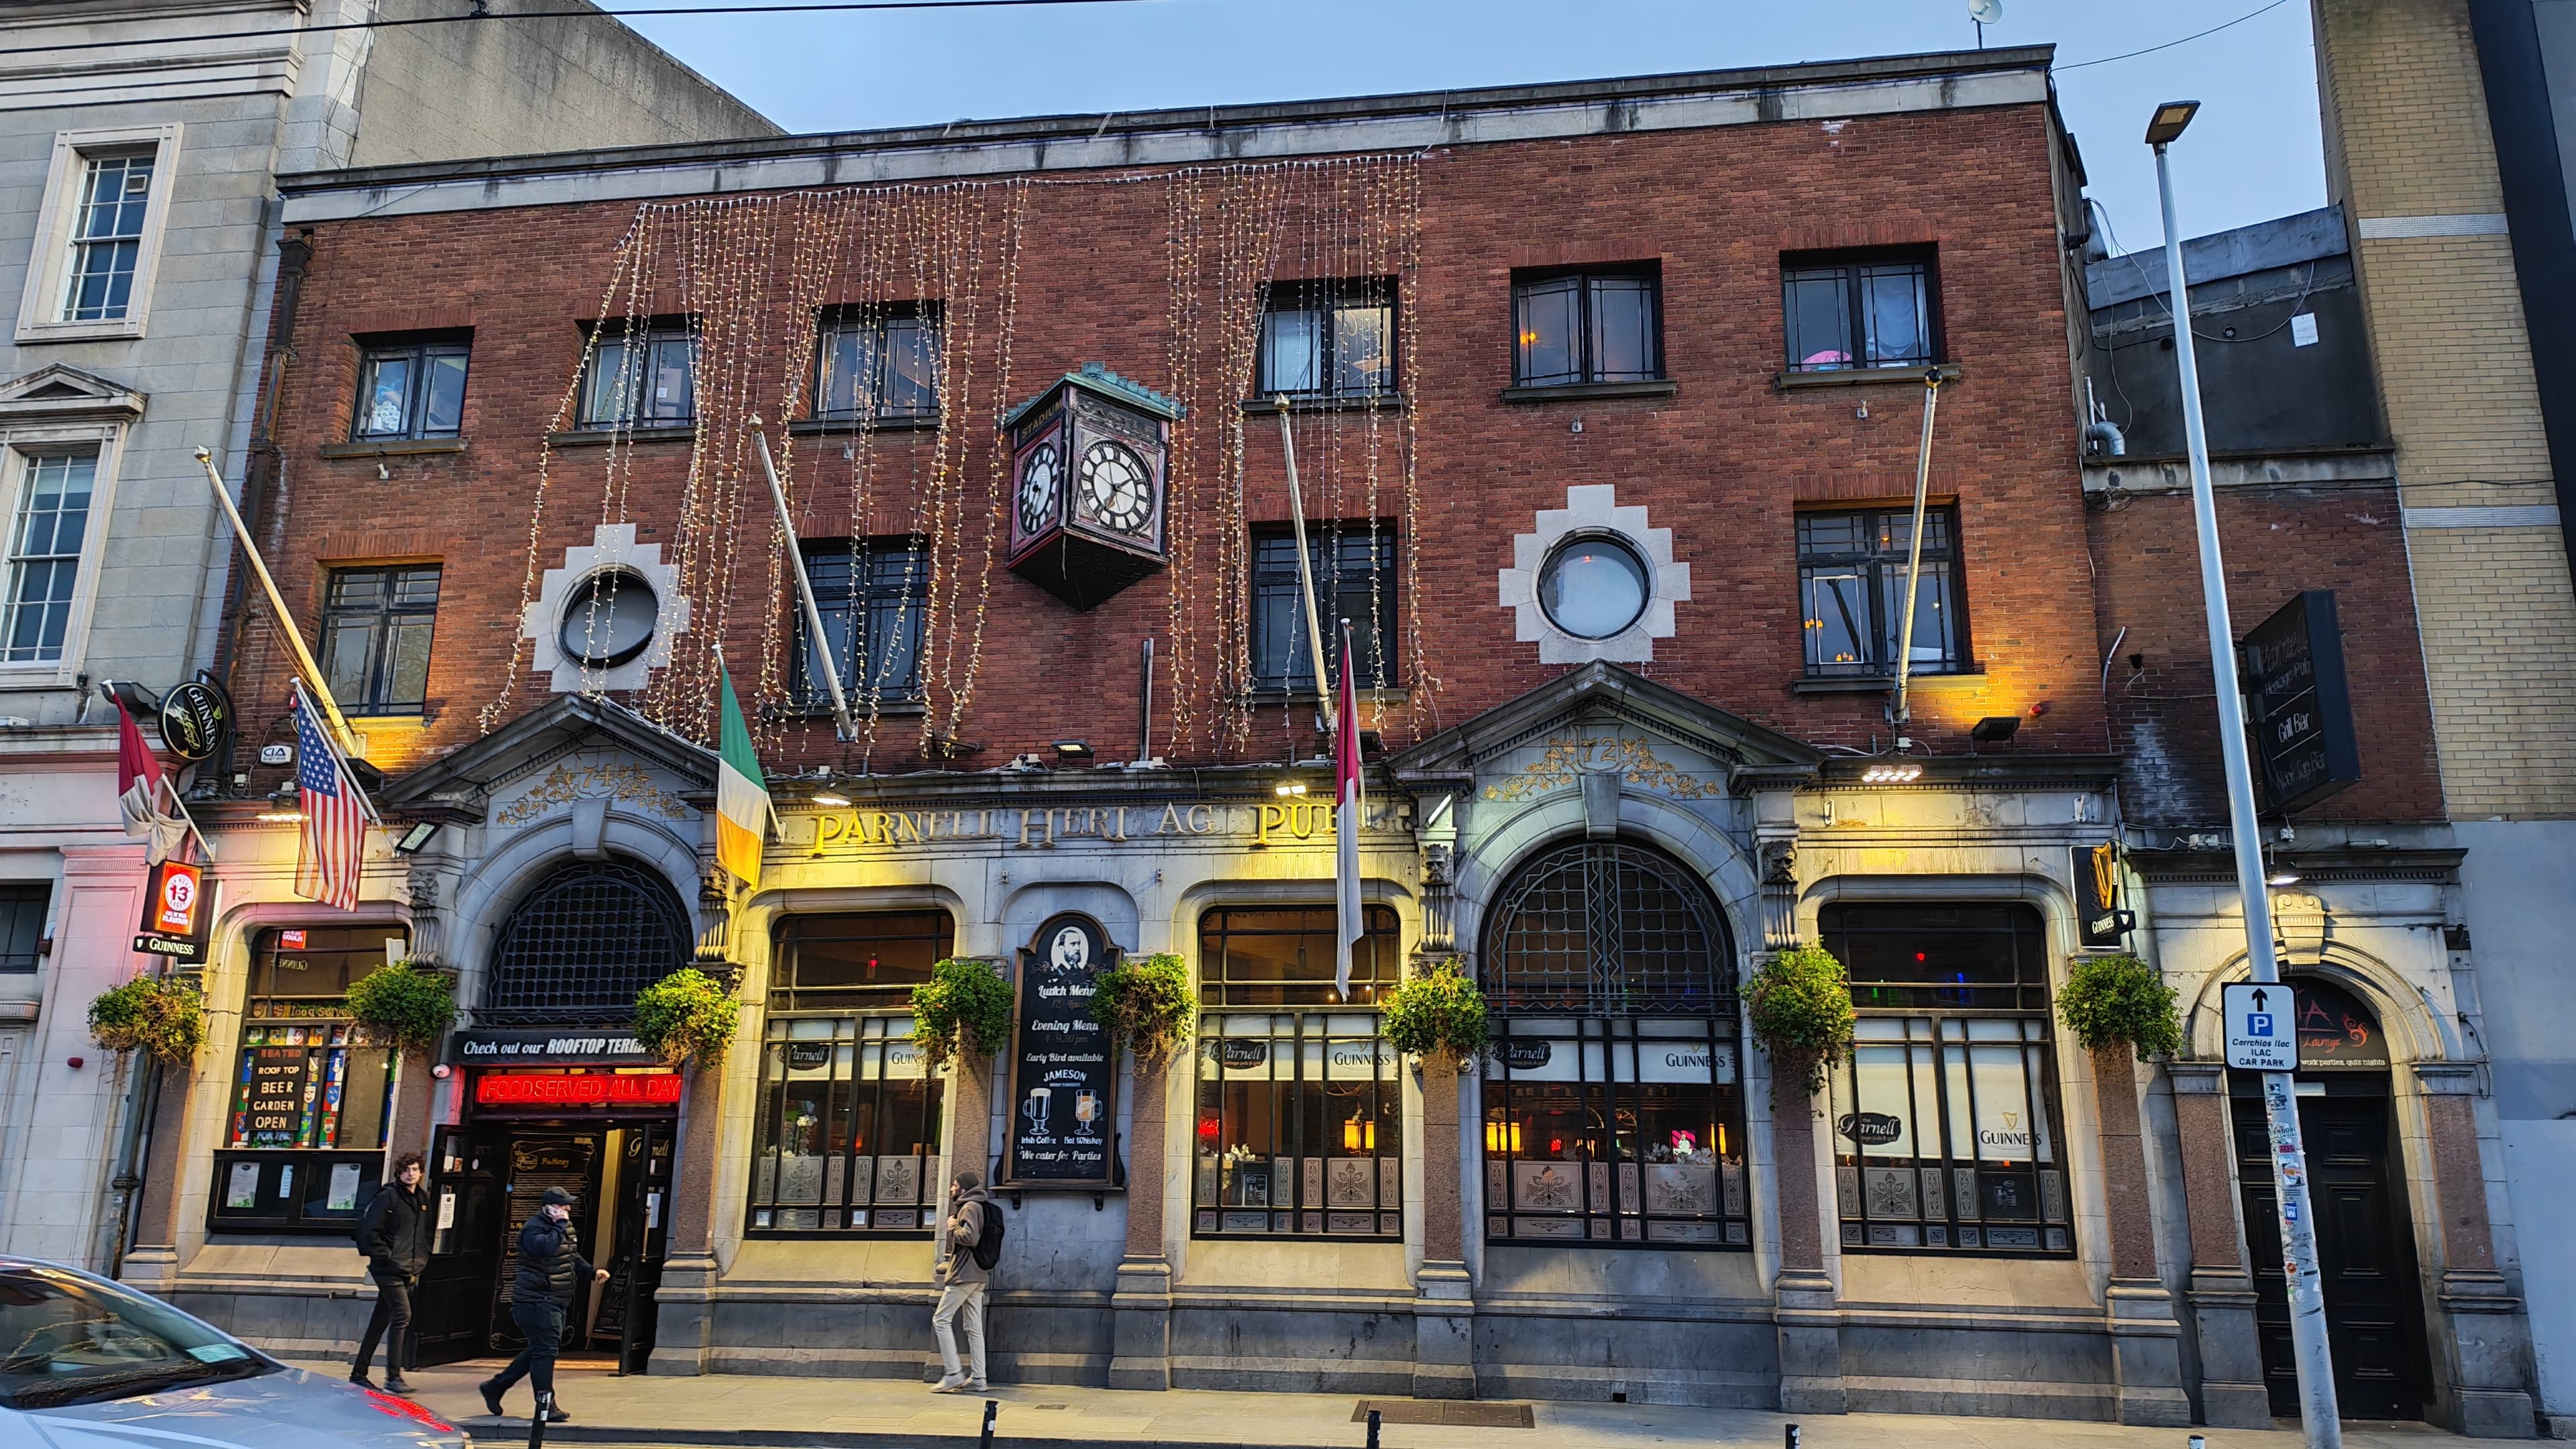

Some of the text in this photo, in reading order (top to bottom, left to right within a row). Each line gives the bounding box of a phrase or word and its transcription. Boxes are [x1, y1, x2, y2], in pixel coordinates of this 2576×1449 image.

[1021, 398, 1063, 437] STADIUM
[188, 687, 215, 752] GUINNESS
[2293, 711, 2310, 733] Bar
[264, 747, 286, 757] CIA
[1581, 737, 1616, 762] 72
[583, 763, 612, 788] 74
[812, 809, 1001, 857] PARNELL
[170, 885, 189, 902] 13
[2092, 916, 2114, 934] GUINNESS
[149, 938, 195, 955] GUINNESS
[1032, 1020, 1099, 1034] Evening Menu
[2254, 1017, 2268, 1034] P
[464, 1040, 497, 1055] Check
[500, 1042, 520, 1055] out
[521, 1042, 544, 1055] our
[546, 1038, 606, 1055] ROOFTOP
[1211, 1042, 1264, 1060] Parnell
[1492, 1042, 1549, 1060] Parnell
[2303, 1036, 2340, 1053] Lounge
[1026, 1053, 1104, 1064] Early Bird available
[258, 1066, 299, 1075] ROOF TOP
[1043, 1069, 1087, 1082] JAMESON
[261, 1081, 294, 1093] BEER
[608, 1079, 639, 1097] ALL
[646, 1079, 682, 1097] DAY
[254, 1101, 294, 1111] GARDEN
[256, 1116, 287, 1128] OPEN
[1076, 1137, 1103, 1146] Whiskey
[1980, 1130, 2041, 1145] GUINNES
[1020, 1150, 1034, 1160] We
[1035, 1152, 1057, 1160] cater
[1072, 1150, 1102, 1161] Parties
